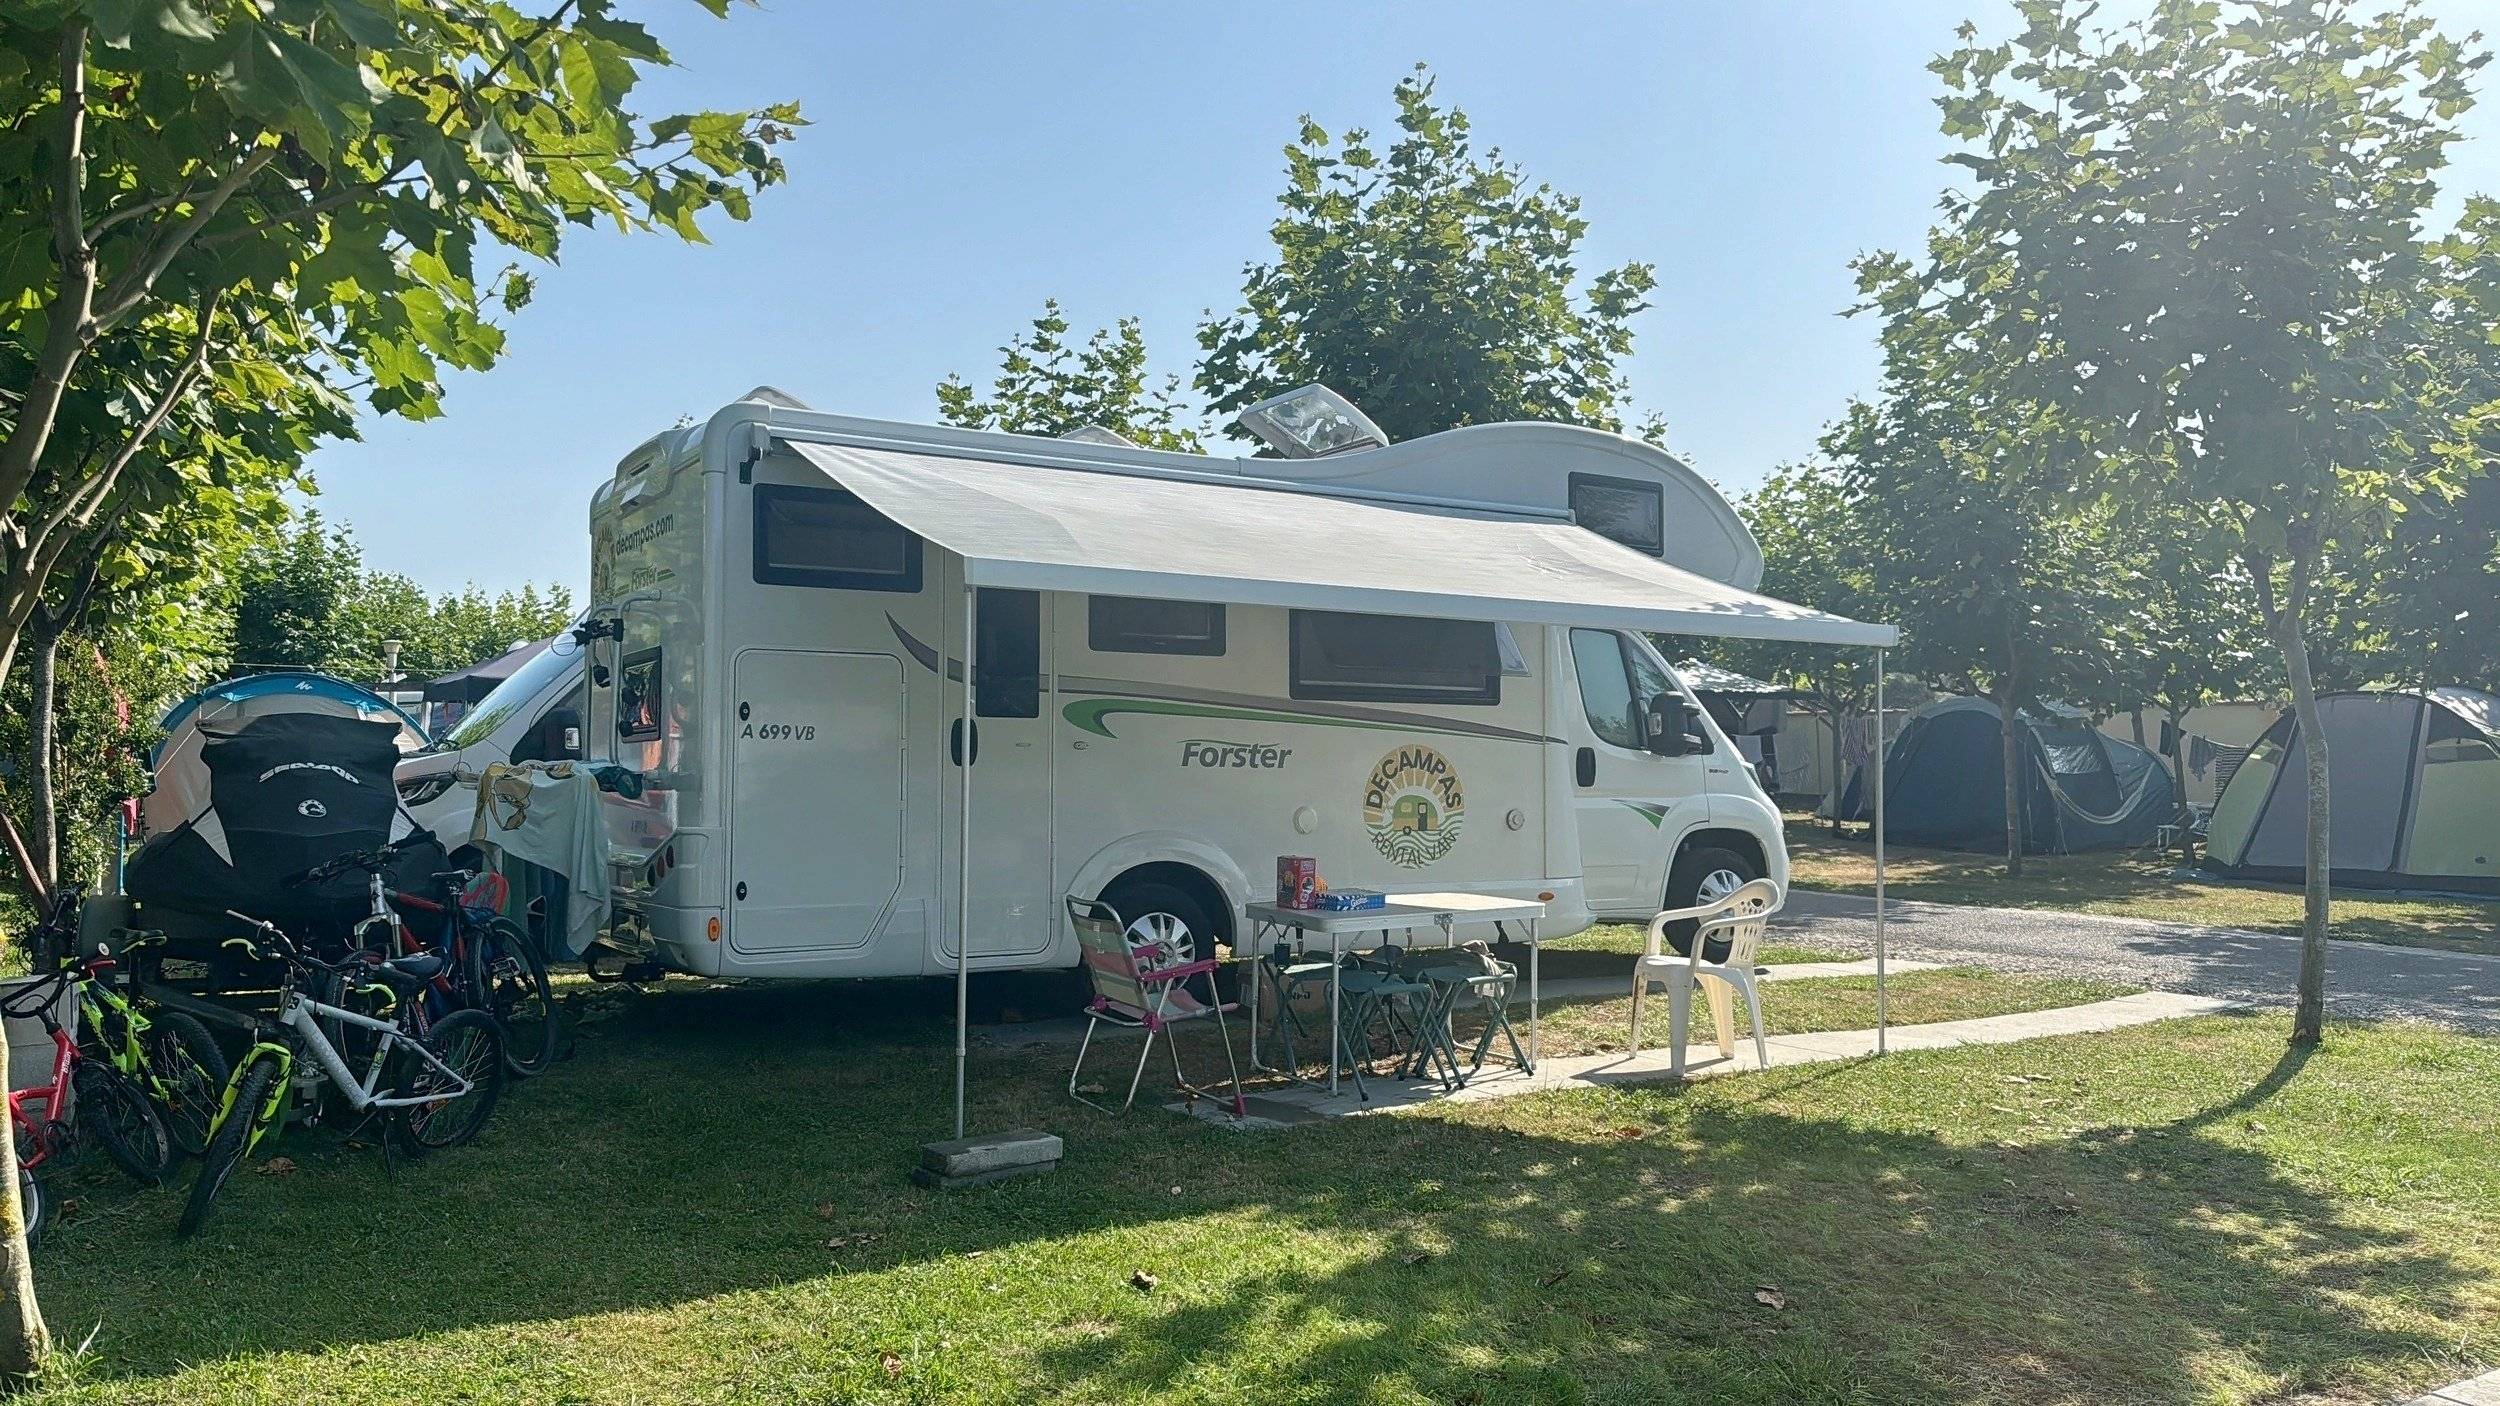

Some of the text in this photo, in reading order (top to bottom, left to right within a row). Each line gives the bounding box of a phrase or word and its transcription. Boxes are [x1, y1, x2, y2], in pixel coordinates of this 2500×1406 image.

[616, 513, 674, 556] decampas.com
[740, 723, 816, 741] A 699 VB
[1181, 741, 1293, 769] Forster
[1365, 748, 1462, 809] DECAMPAS
[1371, 832, 1424, 865] RENTAL
